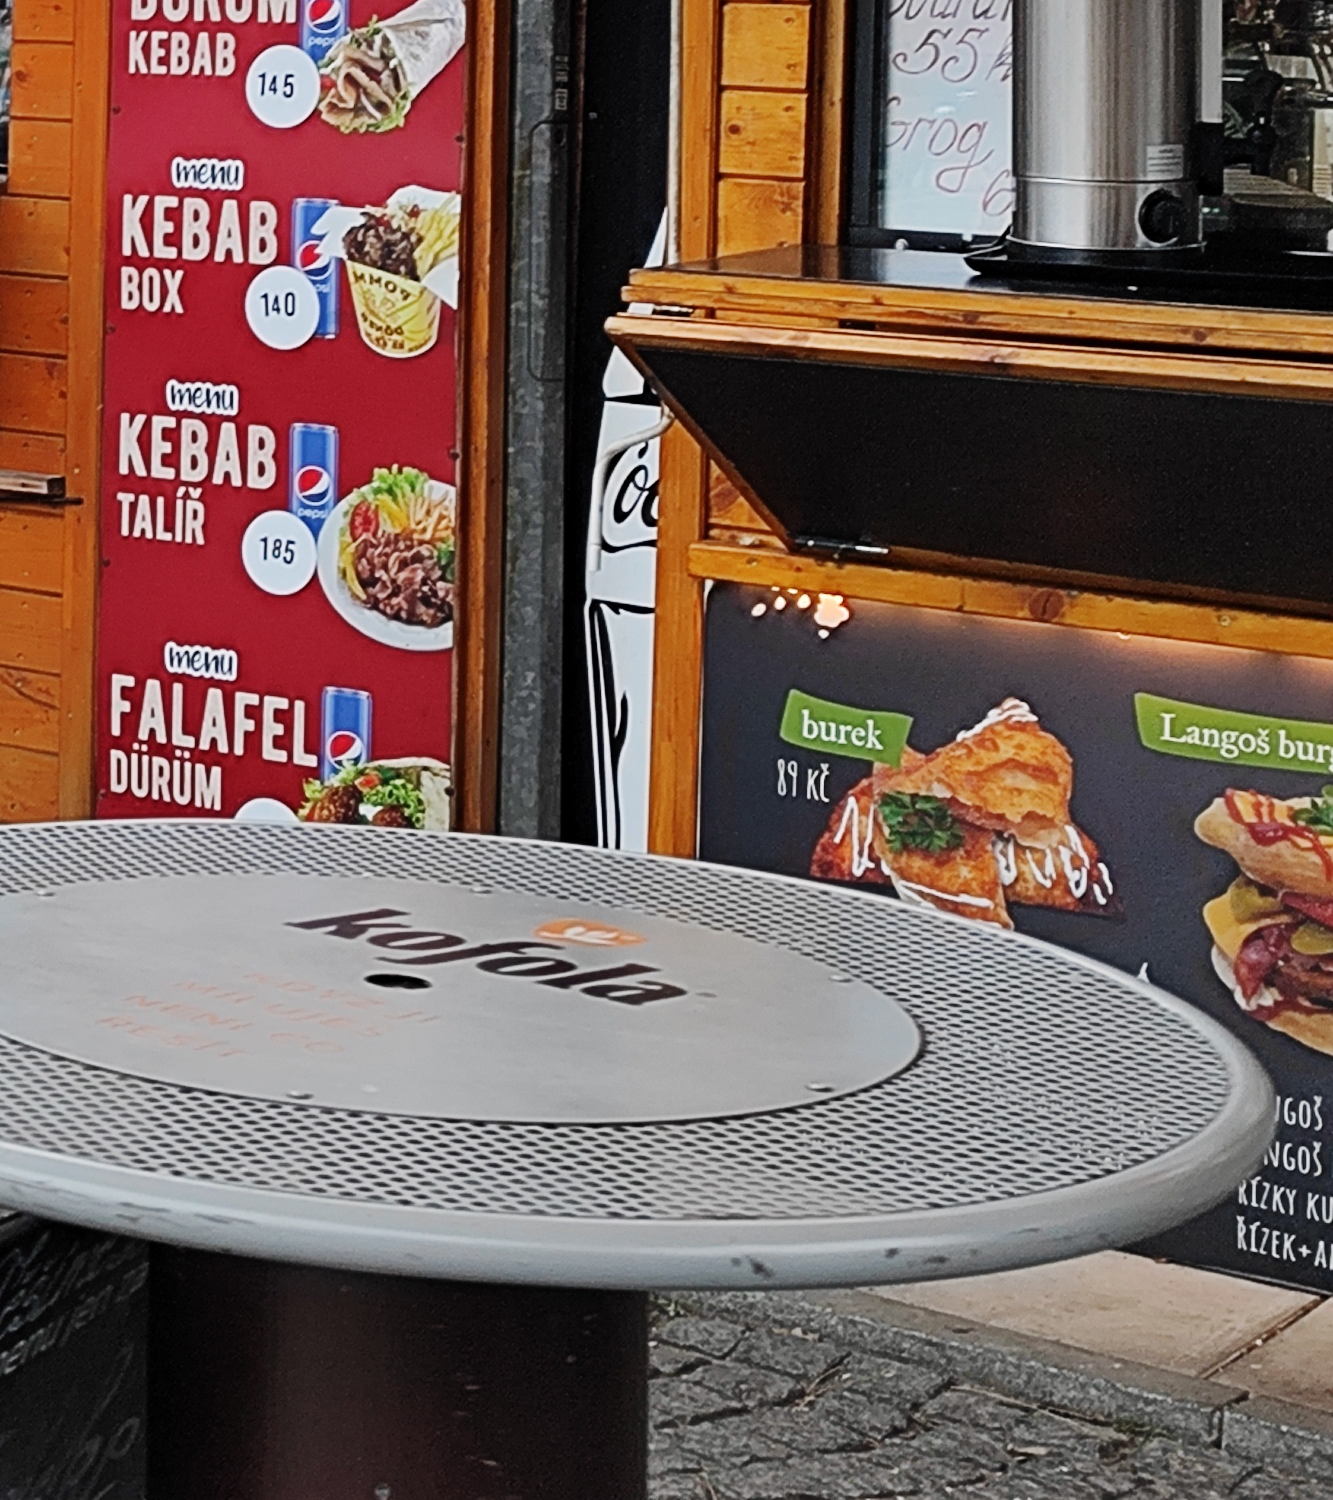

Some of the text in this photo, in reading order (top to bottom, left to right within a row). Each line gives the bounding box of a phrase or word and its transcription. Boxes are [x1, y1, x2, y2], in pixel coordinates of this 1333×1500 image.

[128, 30, 236, 77] KEBAB
[892, 28, 989, 83] 55
[257, 73, 295, 99] 145
[175, 158, 240, 186] menu
[122, 194, 278, 266] KEBAB
[121, 267, 184, 314] BOX
[260, 292, 296, 318] 140
[170, 382, 234, 412] menu
[118, 412, 277, 490] KEBAB
[116, 486, 205, 546] TALÍŘ
[260, 536, 297, 565] 185
[169, 644, 233, 675] menu
[110, 672, 319, 768] FALAFEL
[801, 709, 884, 750] burek
[1159, 713, 1270, 759] Langoš
[109, 743, 222, 810] DÜRÜM
[777, 758, 798, 797] 89
[283, 907, 689, 1007] kofola
